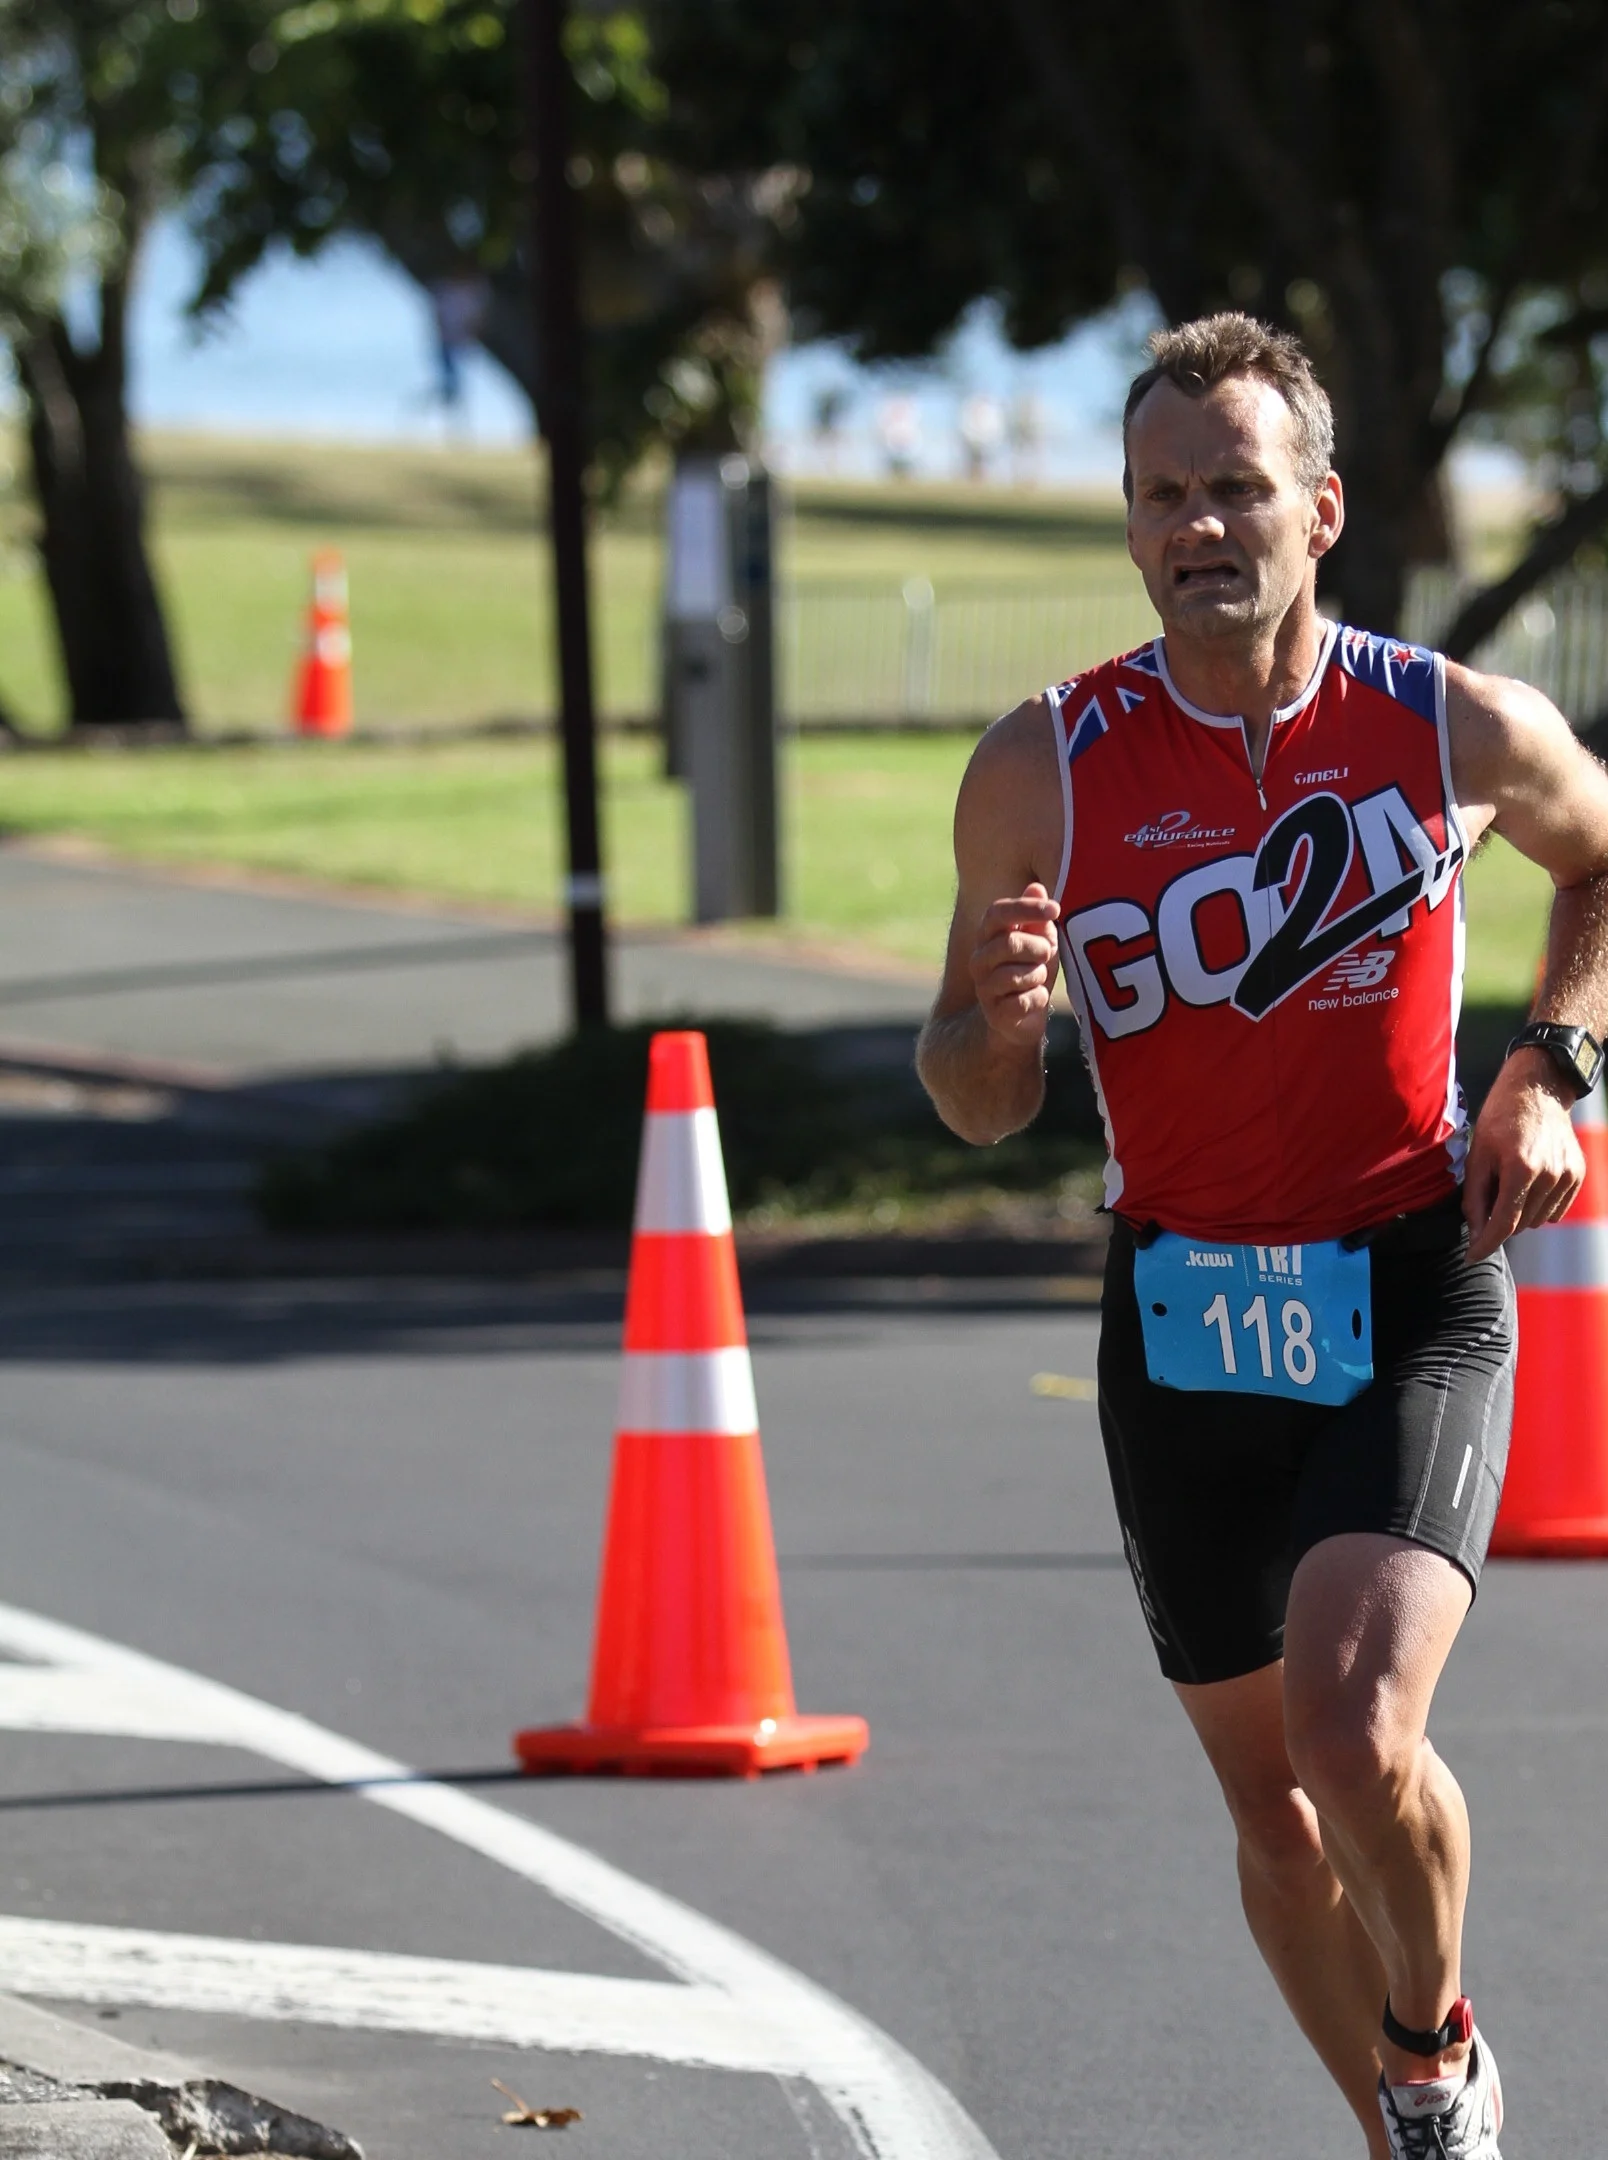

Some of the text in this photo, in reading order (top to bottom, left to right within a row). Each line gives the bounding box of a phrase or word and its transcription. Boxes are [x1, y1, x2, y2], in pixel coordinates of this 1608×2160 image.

[1123, 827, 1236, 843] endurance
[1308, 987, 1400, 1011] new balance
[1252, 1244, 1302, 1275] TRI
[1258, 1274, 1303, 1287] SERIES
[1202, 1293, 1318, 1387] 118
